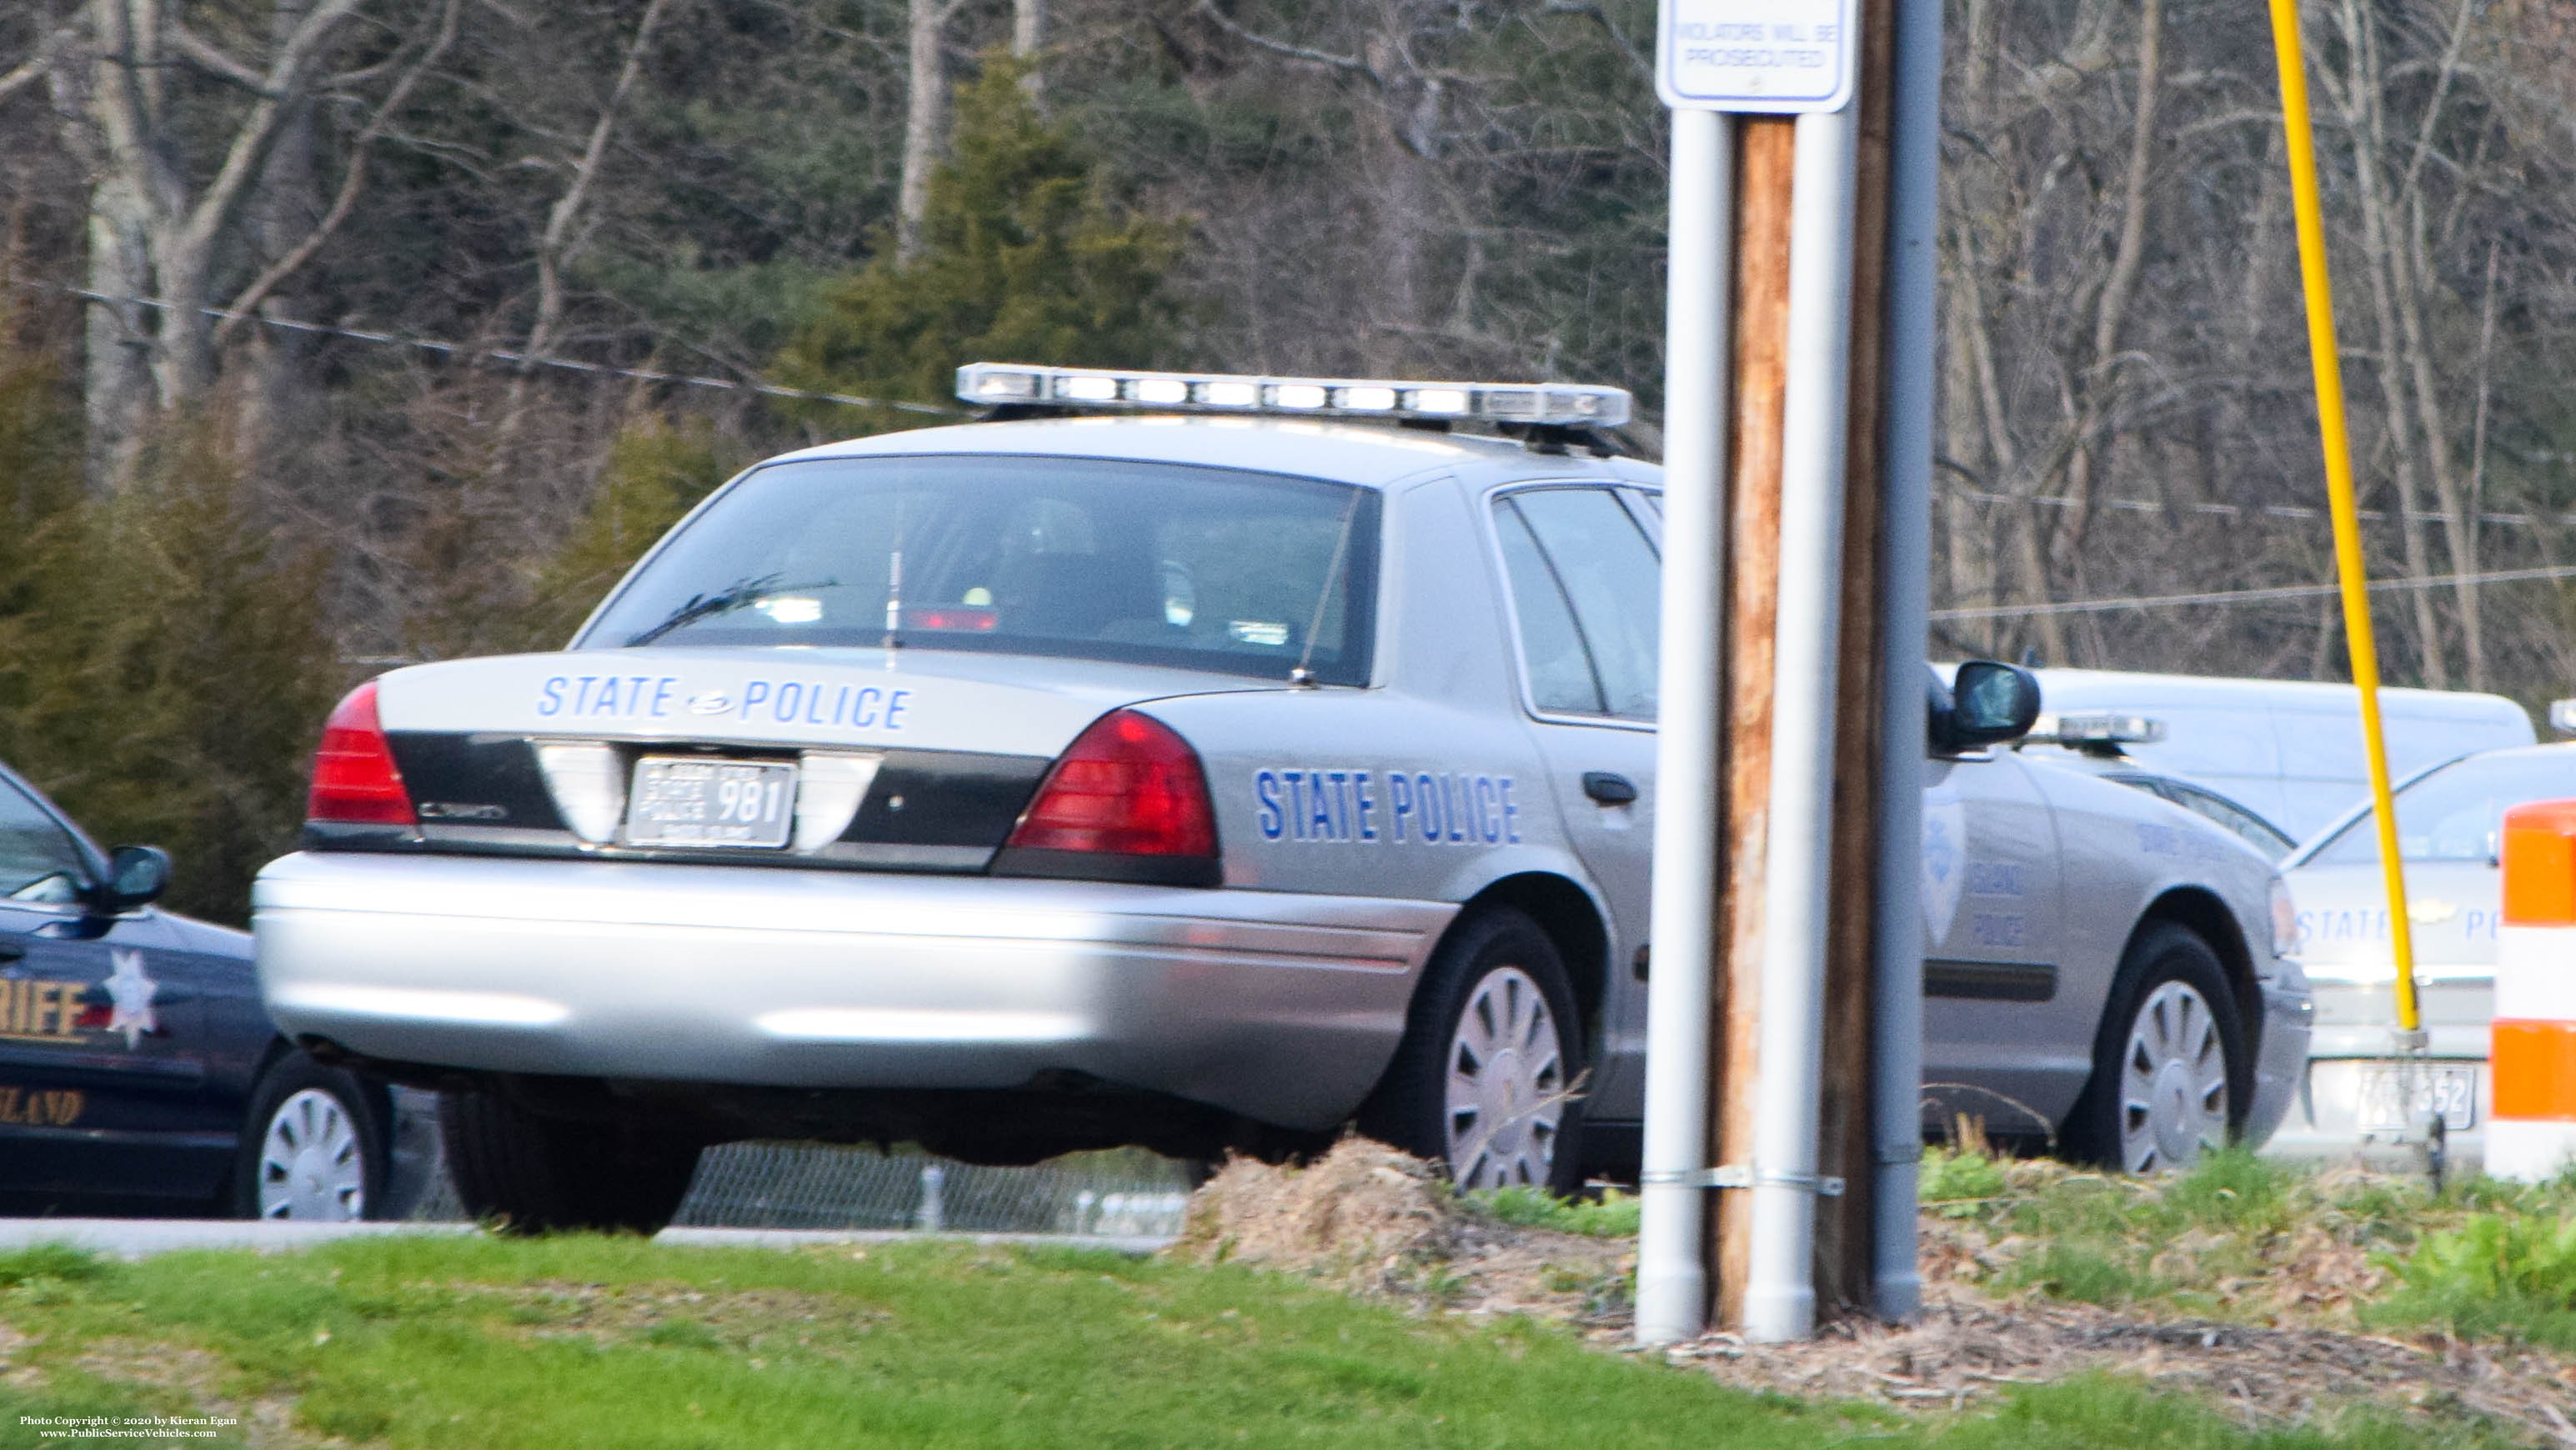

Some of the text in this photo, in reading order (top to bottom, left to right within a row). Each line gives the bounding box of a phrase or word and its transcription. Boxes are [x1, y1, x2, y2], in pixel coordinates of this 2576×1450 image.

[1772, 24, 1807, 43] WILL
[1816, 24, 1839, 43] BE
[1686, 48, 1827, 68] PROSECUTED
[538, 675, 912, 730] STATE POLICE
[718, 779, 782, 823] 981
[1255, 770, 1522, 845] STATE POLICE
